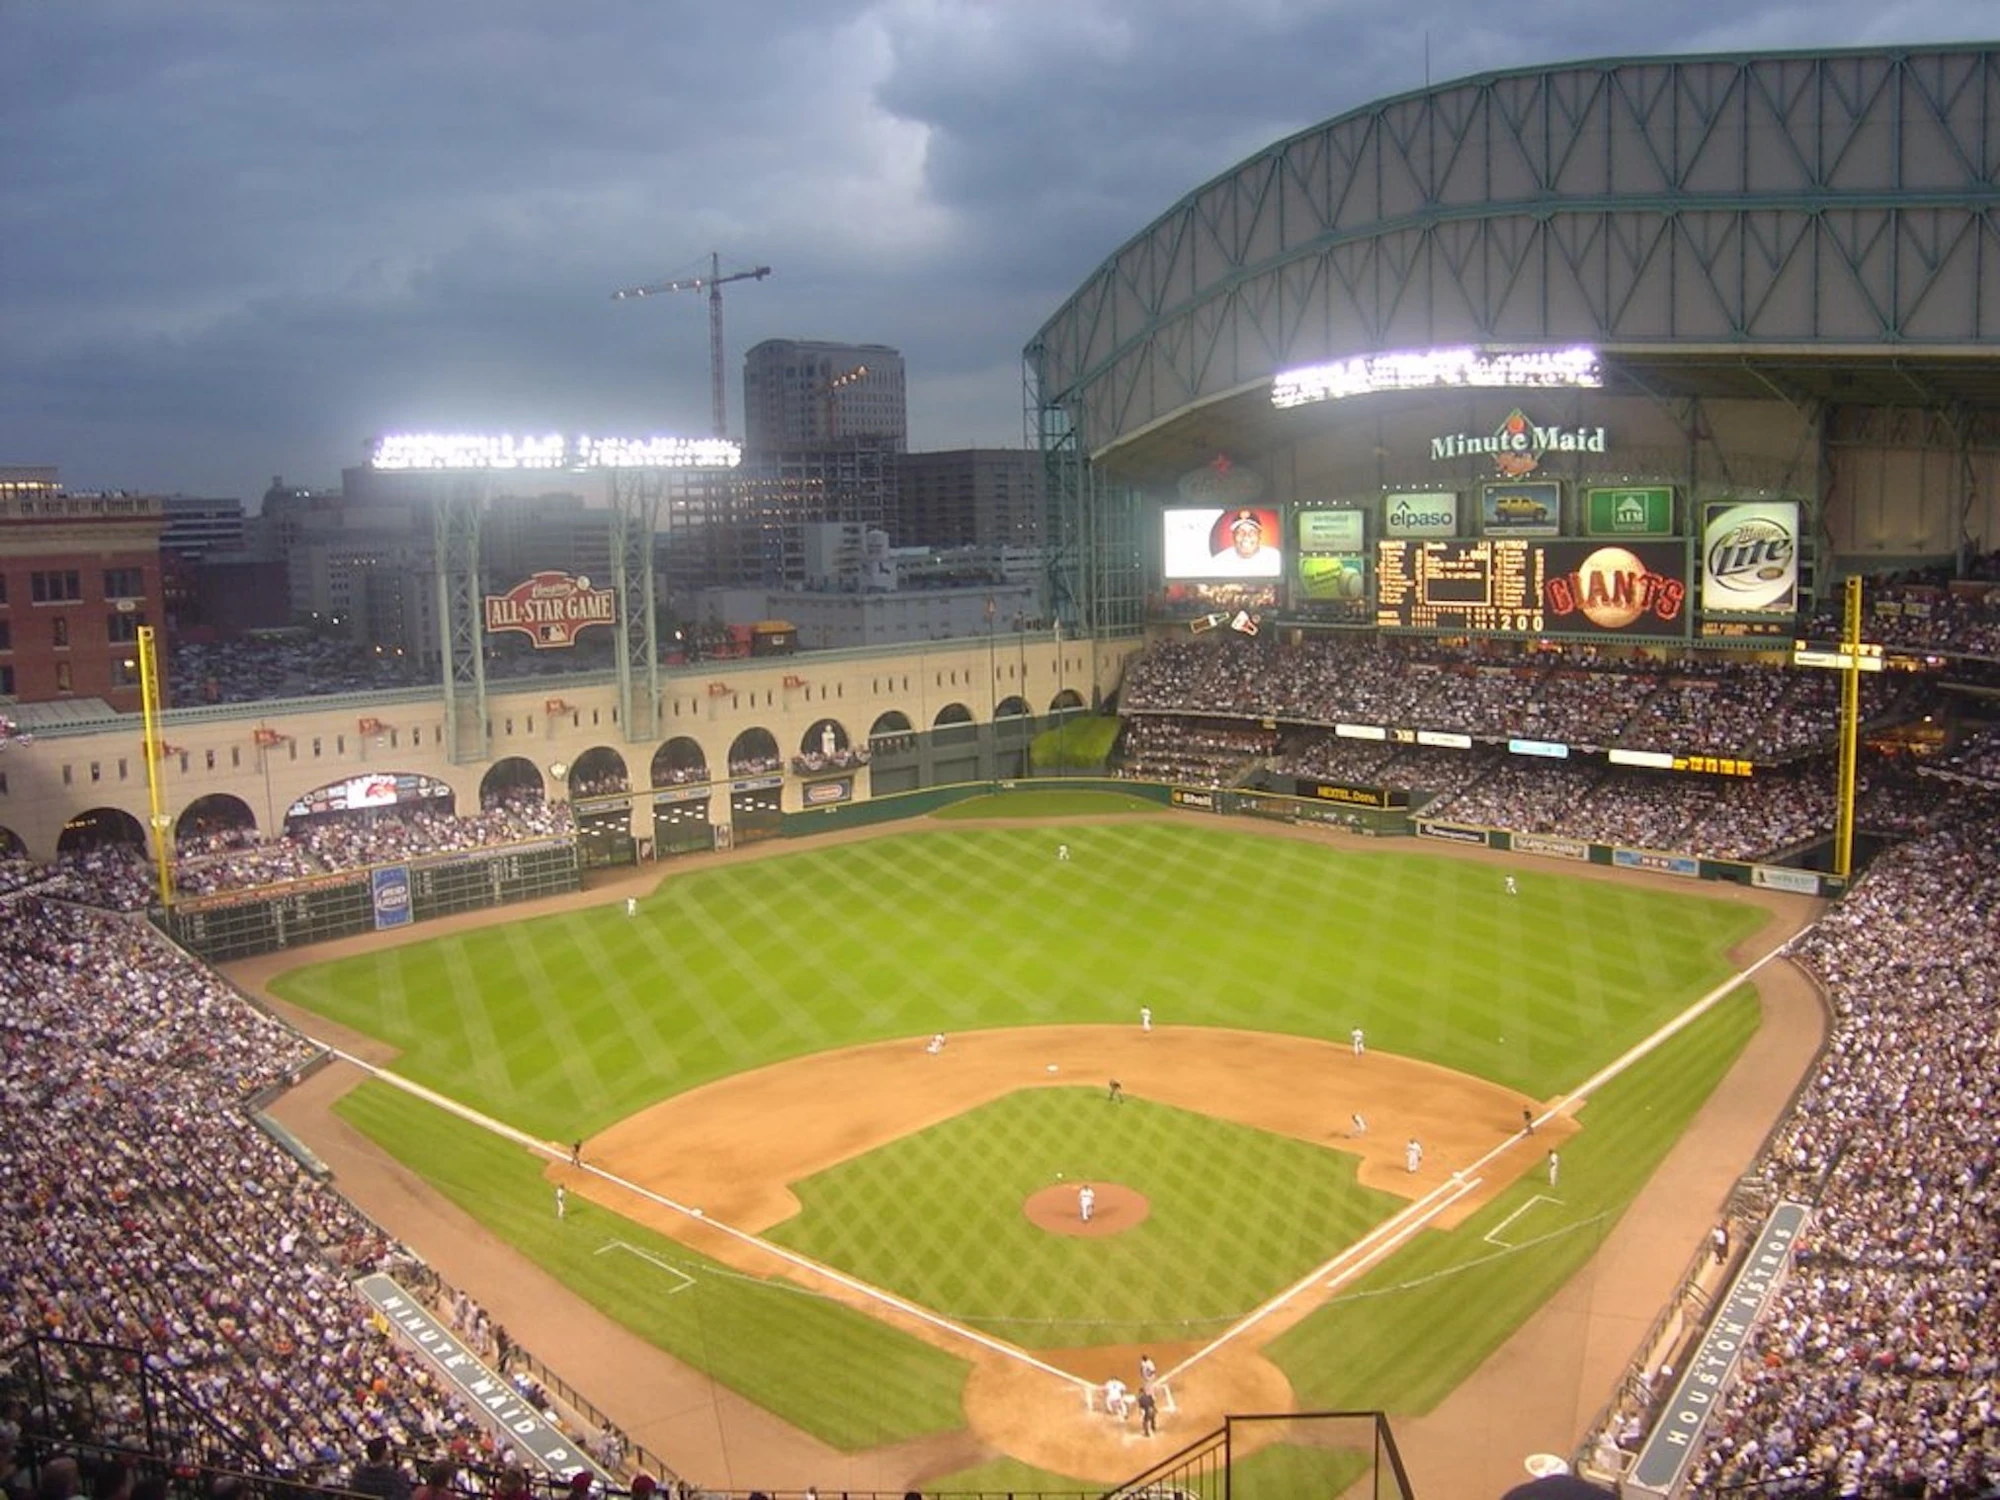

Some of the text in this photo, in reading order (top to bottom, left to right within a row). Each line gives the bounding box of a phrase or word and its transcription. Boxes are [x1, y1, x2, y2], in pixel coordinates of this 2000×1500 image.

[1431, 427, 1606, 460] Minute Maid
[1390, 509, 1453, 529] elpaso
[1715, 538, 1792, 577] Lite
[567, 594, 612, 621] GAME
[1546, 569, 1685, 621] GIANTS
[1500, 614, 1512, 630] 2
[1516, 614, 1528, 631] 0
[1532, 614, 1544, 632] 0
[1667, 1228, 1792, 1446] HOUSTON ASTROS
[381, 1296, 587, 1481] MINUTE MAID PA
